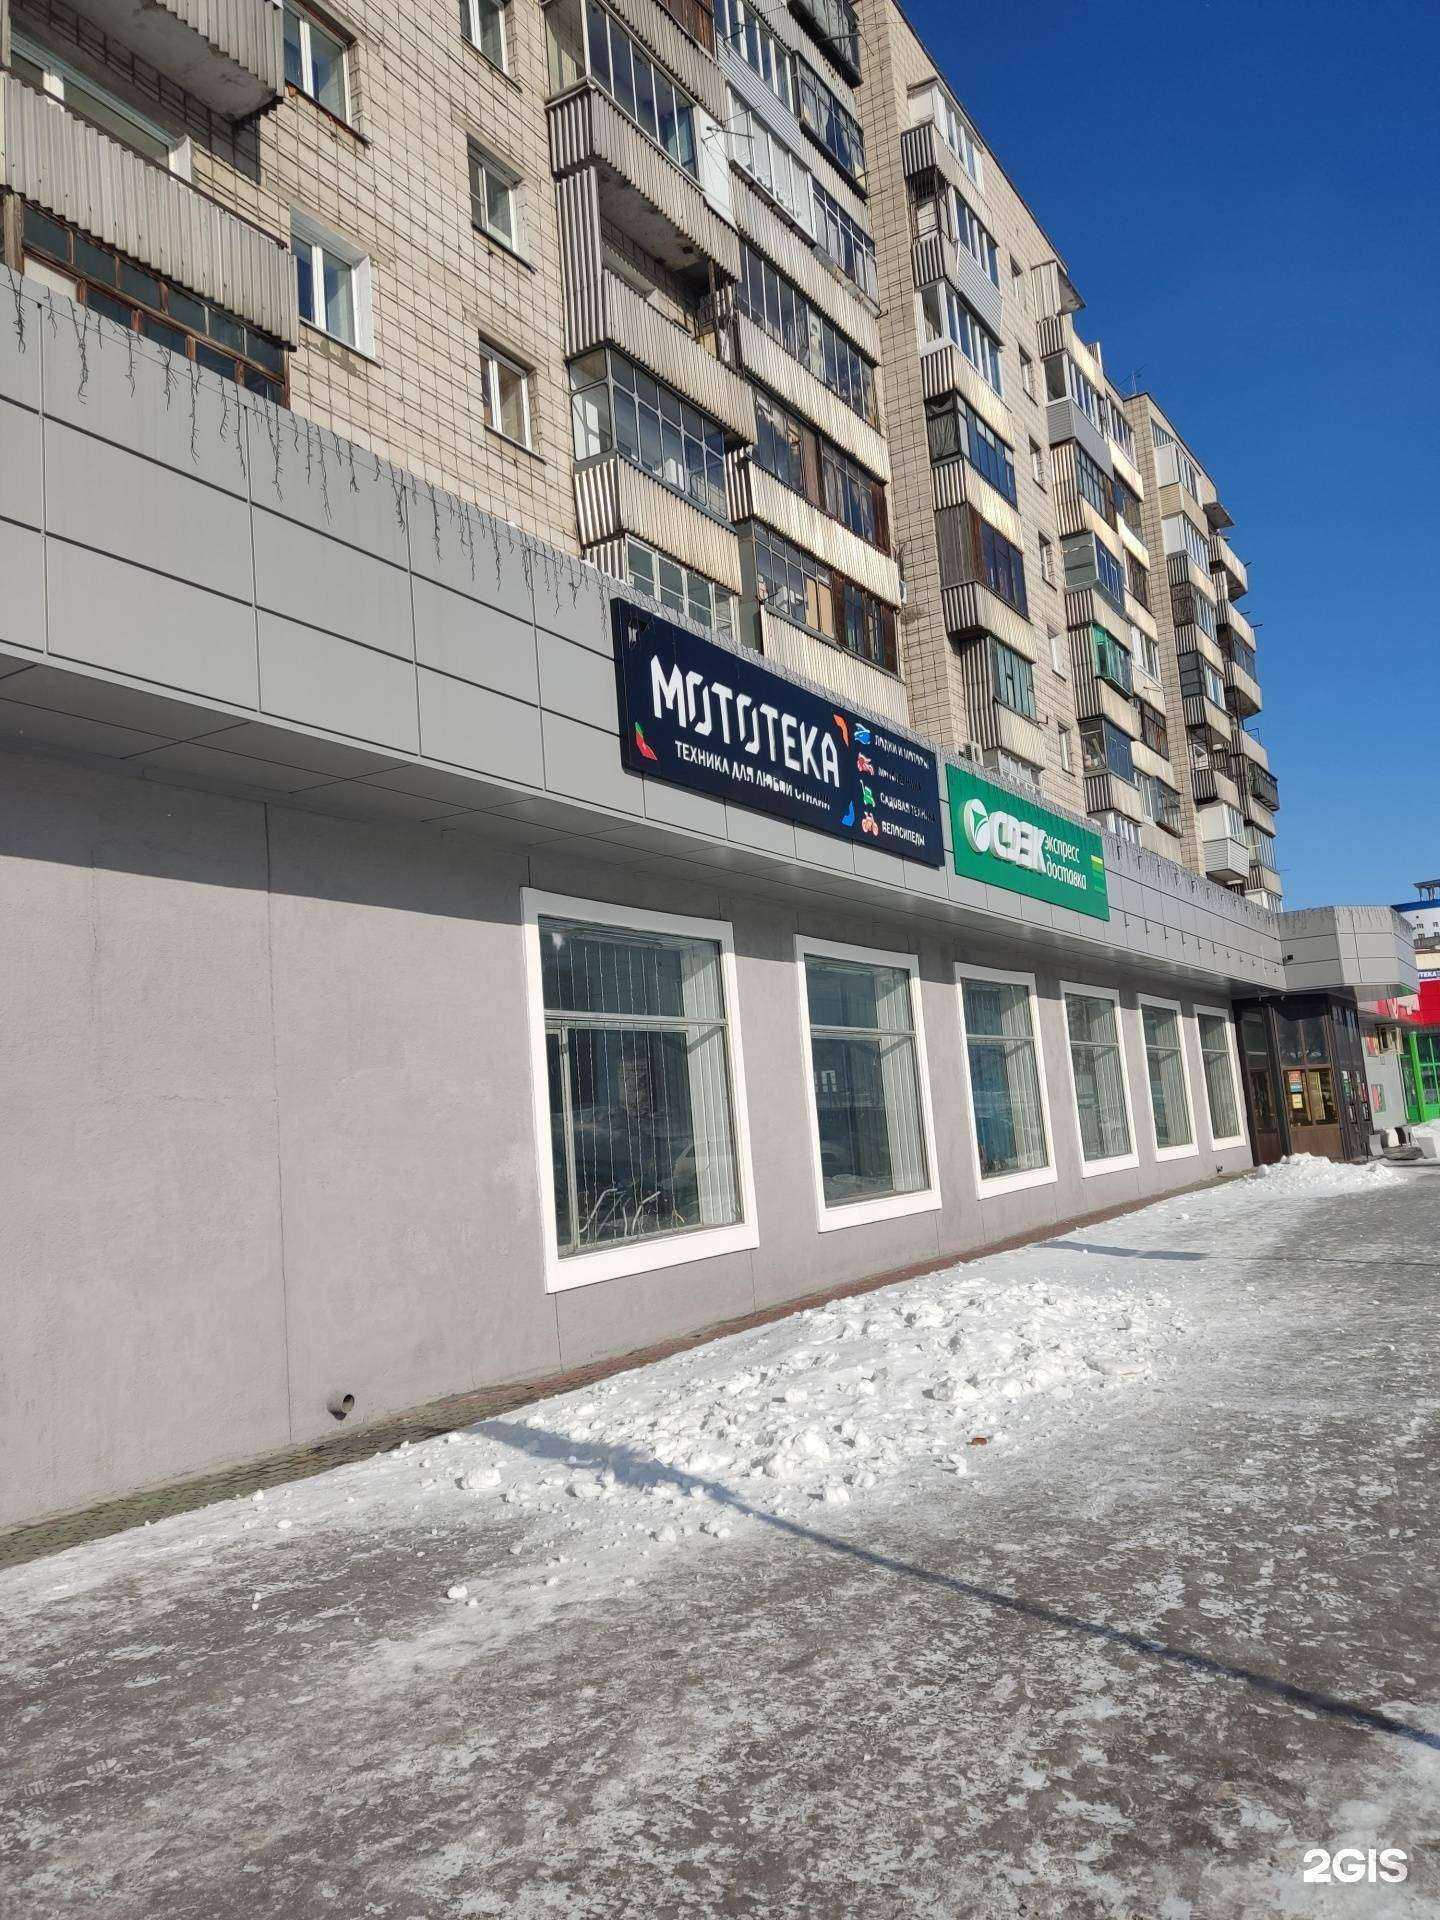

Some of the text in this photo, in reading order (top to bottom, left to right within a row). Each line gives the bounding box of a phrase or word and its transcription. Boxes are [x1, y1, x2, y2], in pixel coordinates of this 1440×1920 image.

[650, 654, 840, 788] МОТОТЕКА
[674, 740, 730, 775] ТЕХНИКА
[732, 761, 754, 782] ДЛЯ
[1046, 853, 1087, 890] доставка
